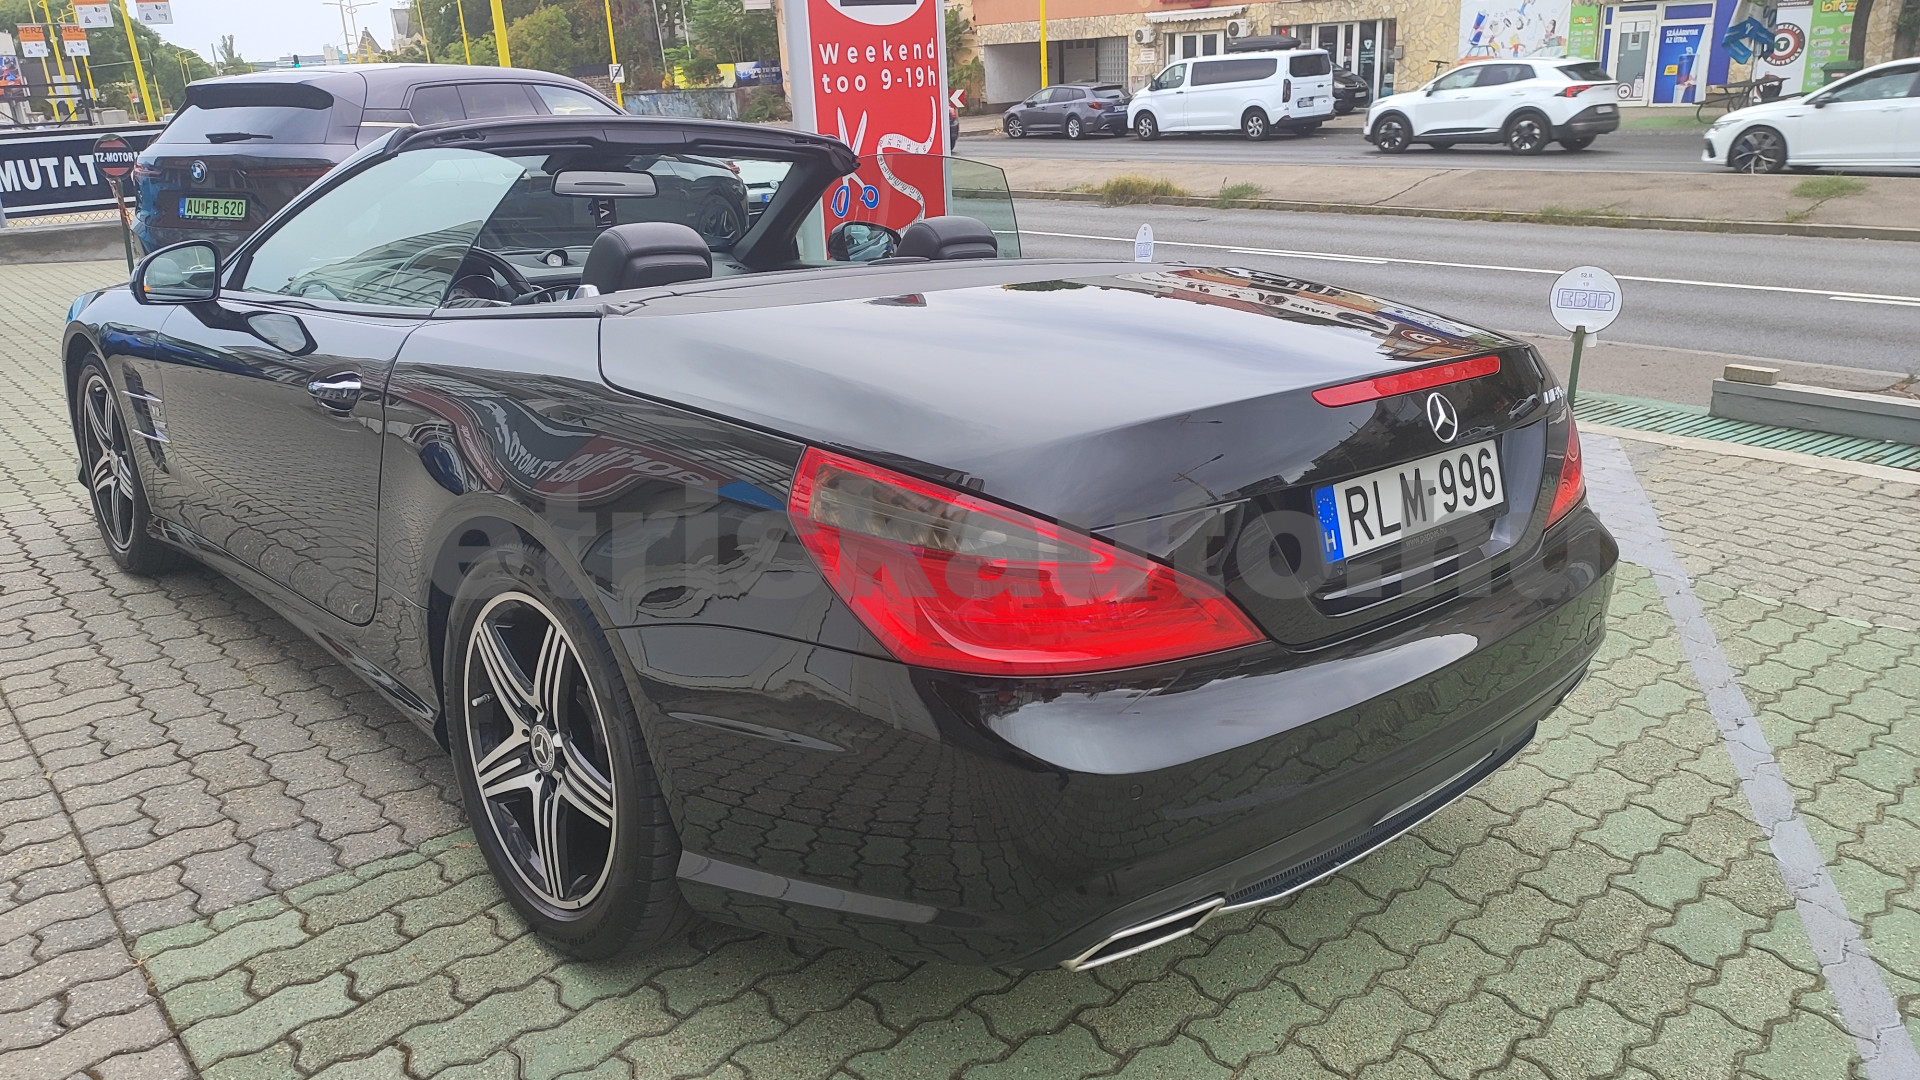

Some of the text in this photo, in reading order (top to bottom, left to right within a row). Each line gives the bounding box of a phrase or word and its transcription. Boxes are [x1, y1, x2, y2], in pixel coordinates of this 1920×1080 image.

[1777, 24, 1801, 34] MZETI
[818, 37, 936, 65] Weekend
[821, 66, 937, 94] too 9-19h
[95, 152, 134, 162] TZ-MOTOR
[205, 200, 244, 216] FB-620
[1560, 290, 1612, 309] EBIP
[1344, 447, 1497, 546] RLM-996
[1324, 529, 1337, 552] H
